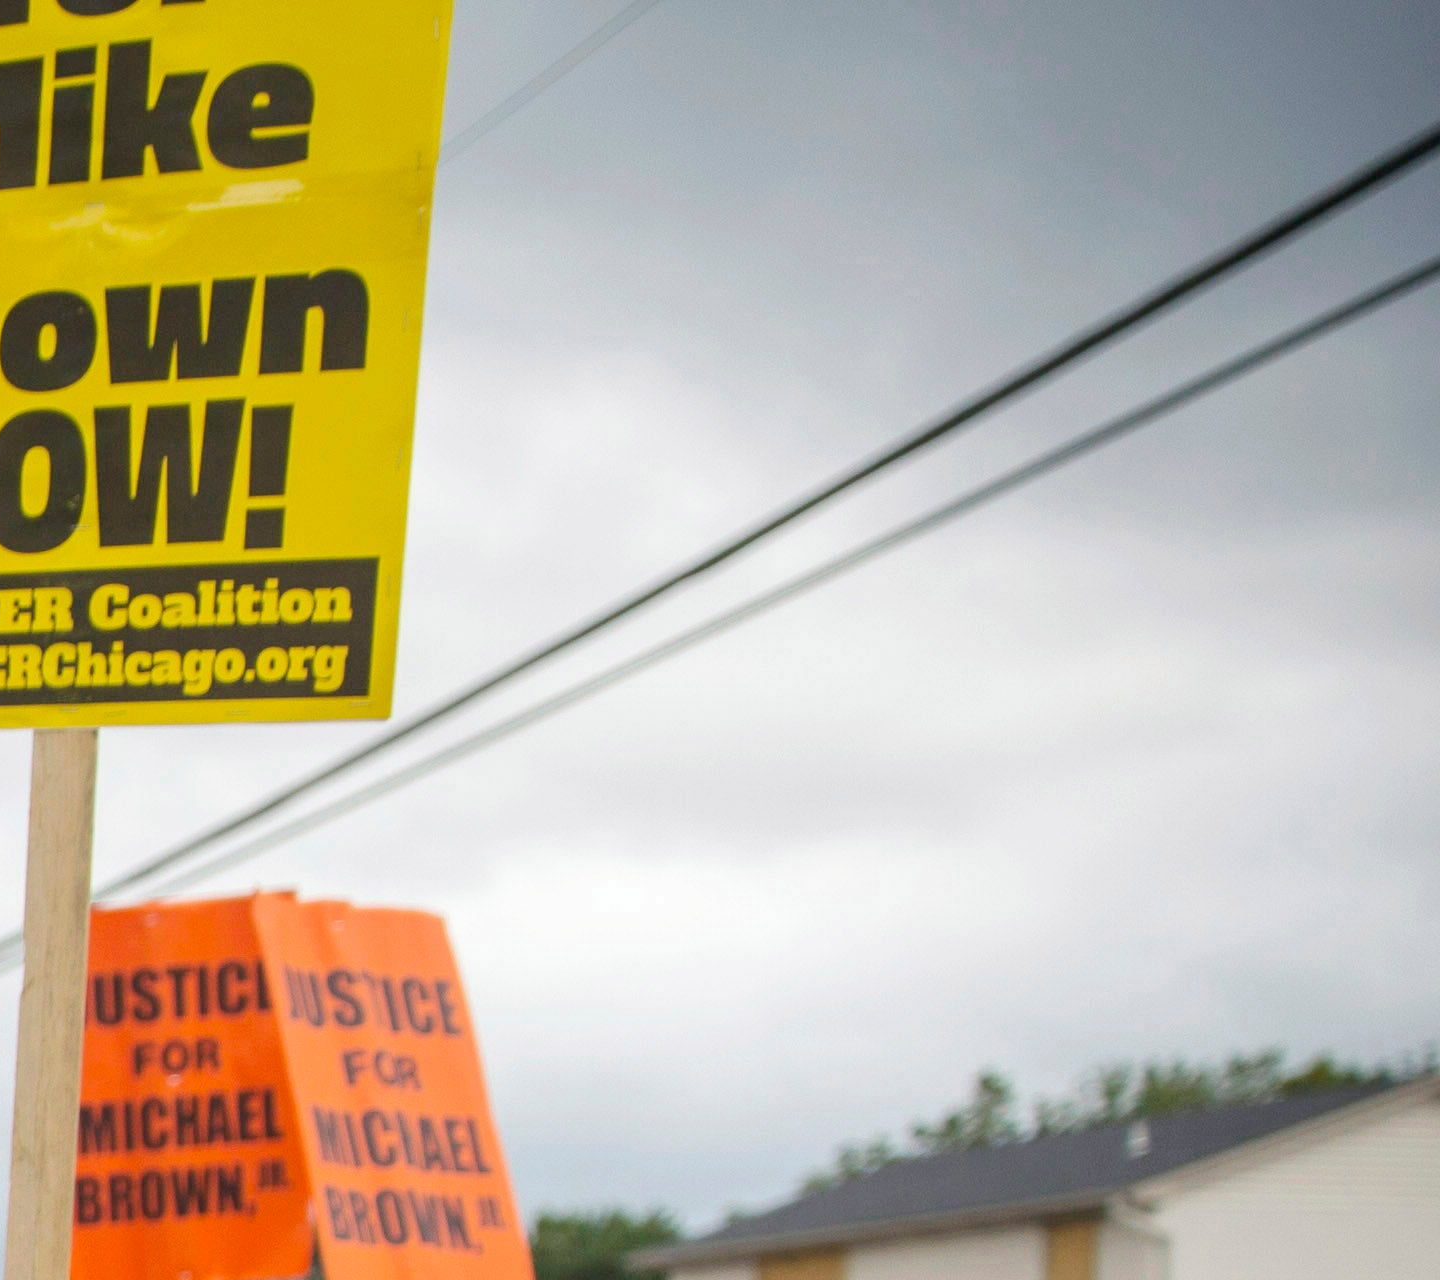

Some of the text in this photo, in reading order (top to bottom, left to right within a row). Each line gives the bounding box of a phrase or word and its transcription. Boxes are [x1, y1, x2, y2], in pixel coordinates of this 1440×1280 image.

[87, 577, 354, 633] Coalition
[85, 957, 272, 1027] USTIC
[132, 1036, 222, 1078] FOR
[78, 1088, 285, 1155] MICHAEL
